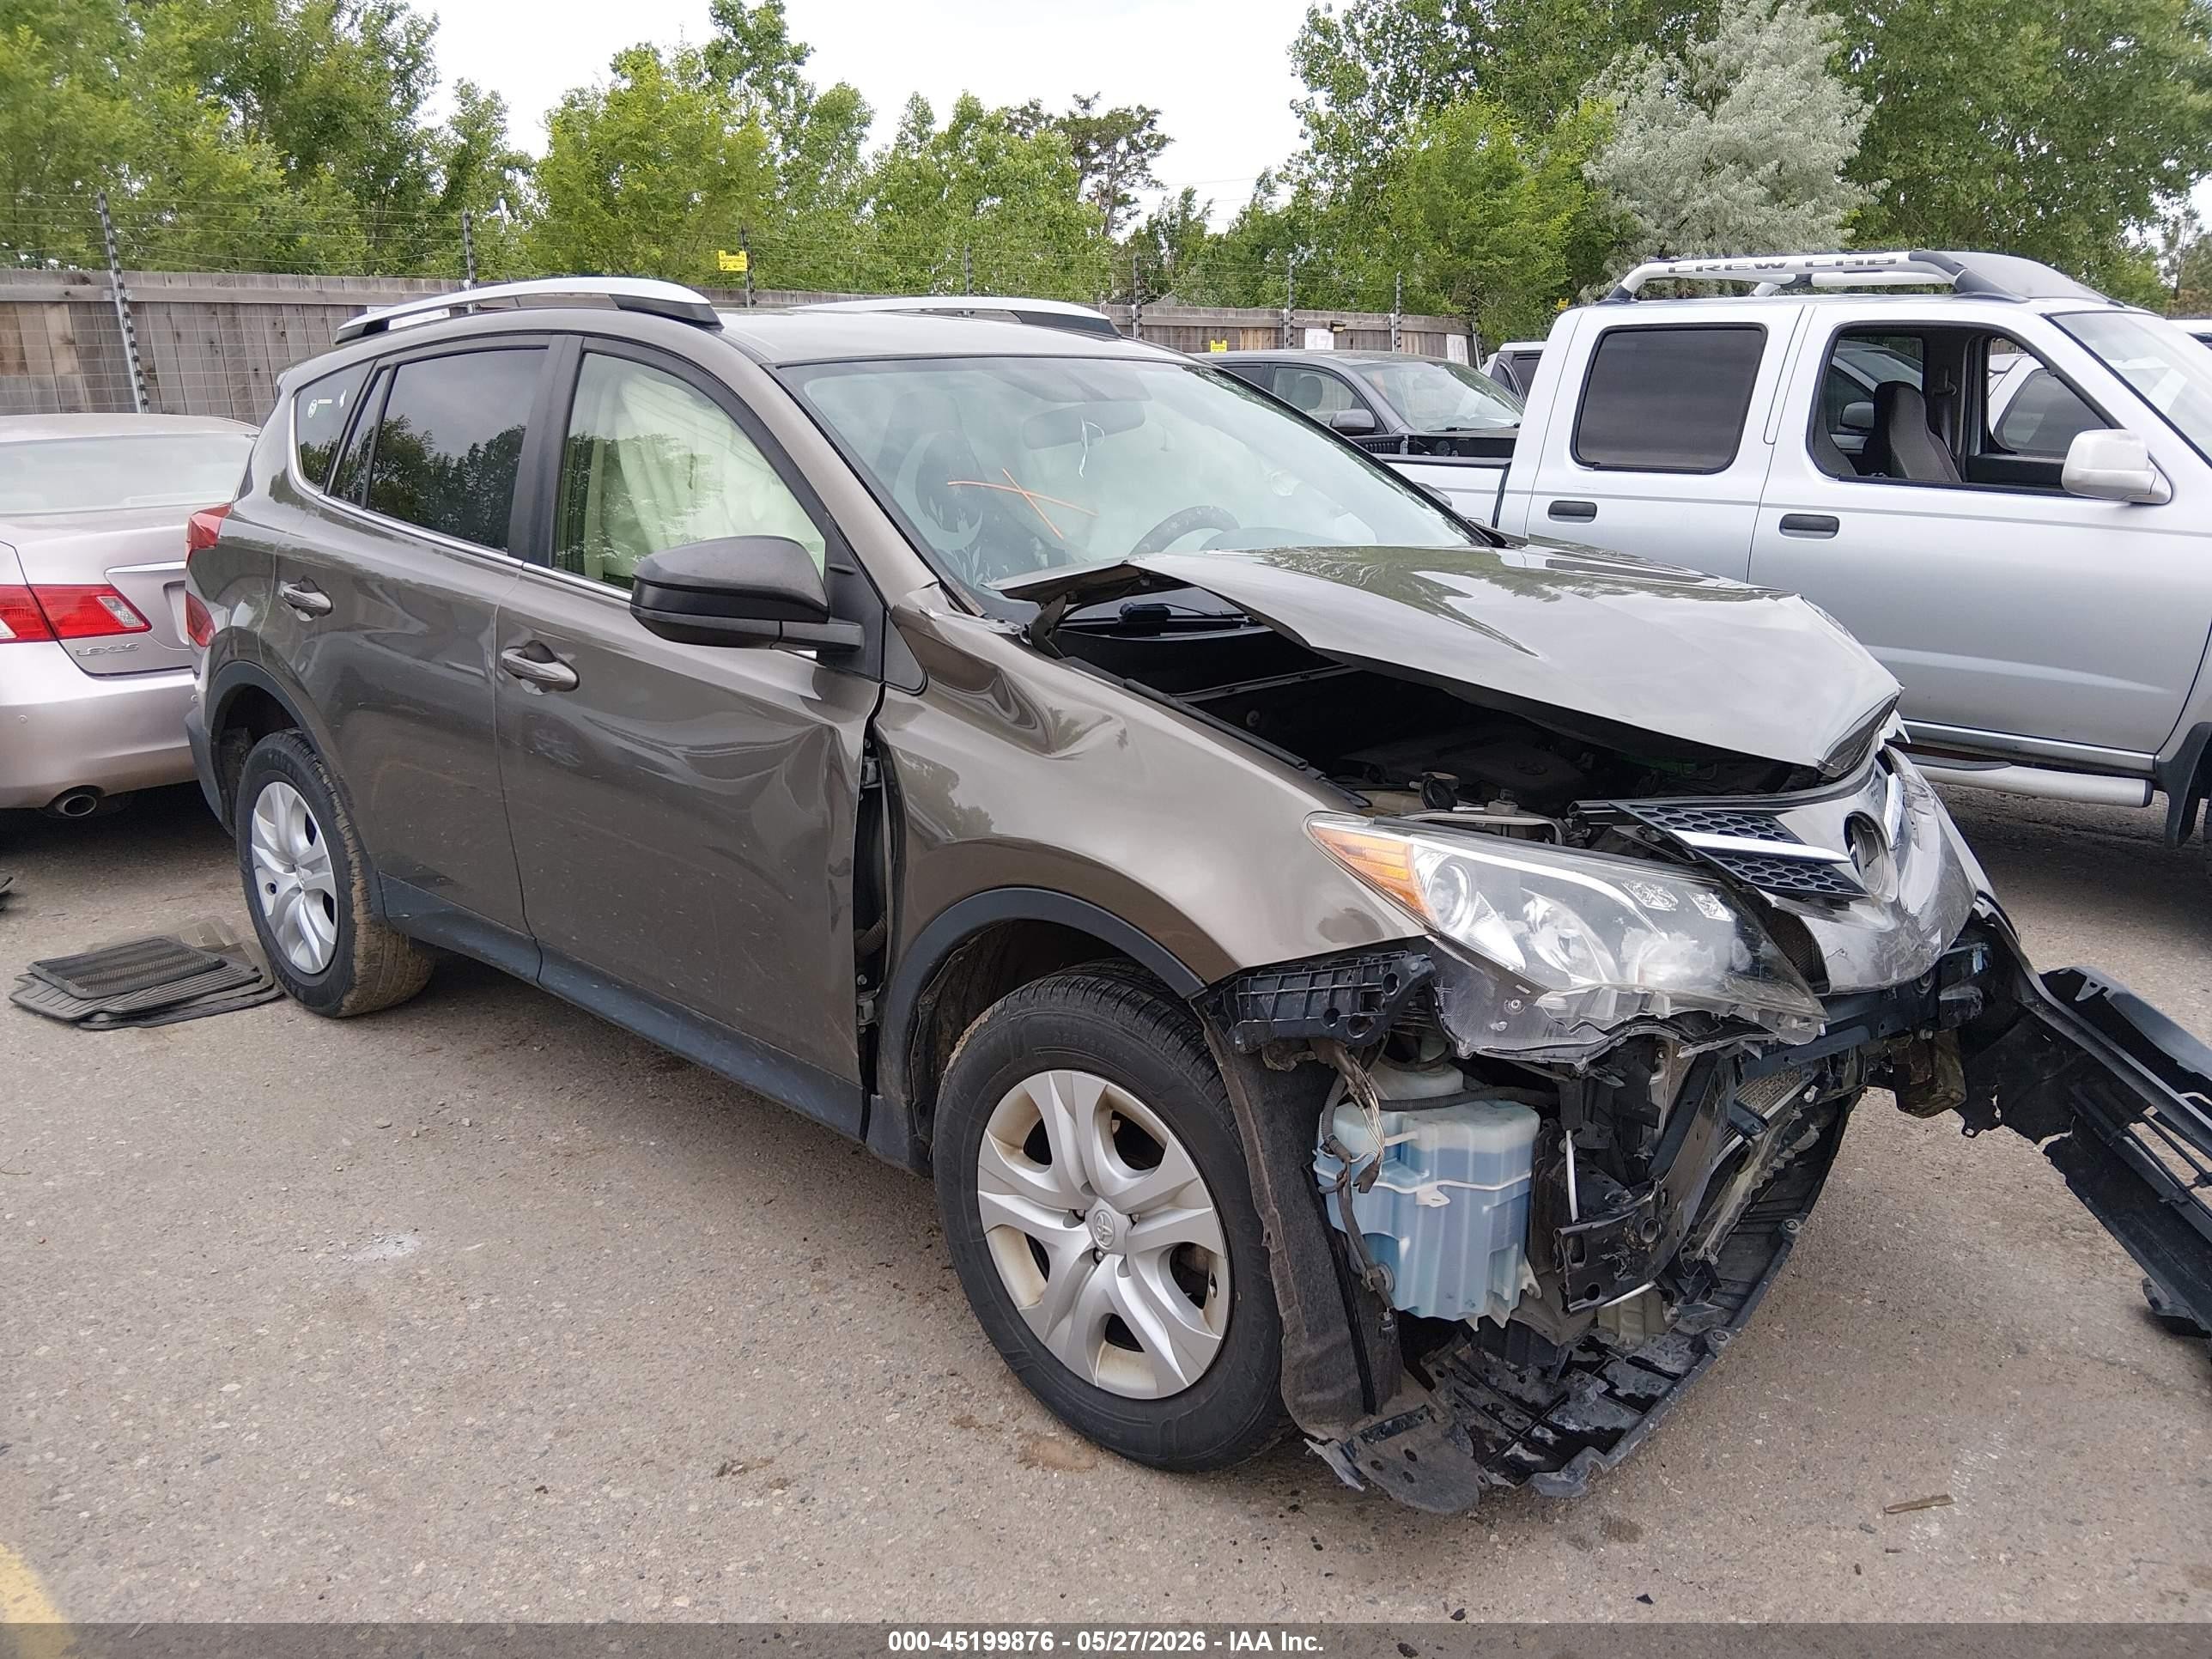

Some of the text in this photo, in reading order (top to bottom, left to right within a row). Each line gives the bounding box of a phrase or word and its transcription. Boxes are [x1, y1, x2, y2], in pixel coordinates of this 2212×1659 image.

[1668, 258, 1897, 273] CREW CAB
[75, 642, 139, 656] LEXUS
